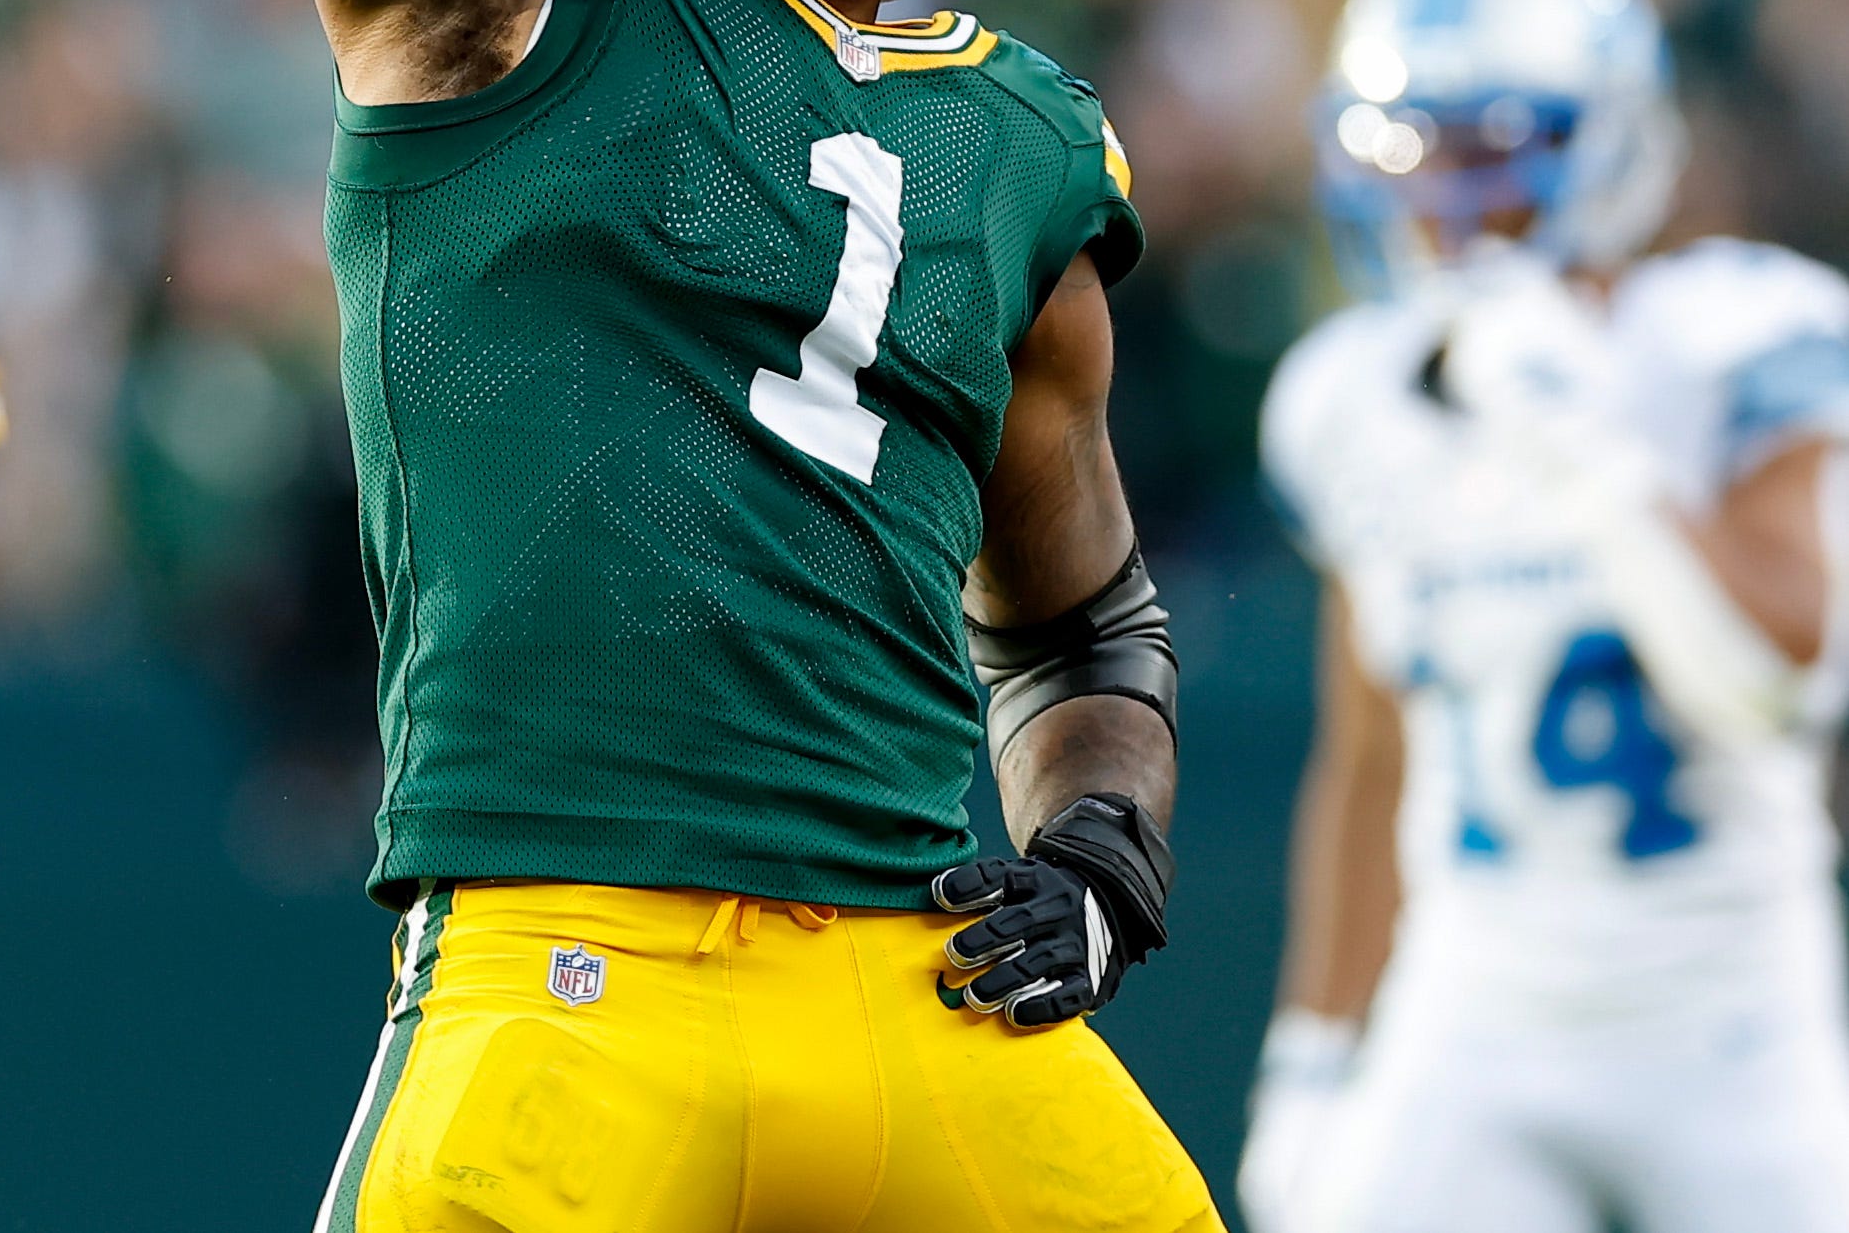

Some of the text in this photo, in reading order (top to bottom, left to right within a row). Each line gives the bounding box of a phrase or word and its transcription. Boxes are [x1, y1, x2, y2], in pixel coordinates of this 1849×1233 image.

[844, 44, 874, 72] NFL
[747, 130, 905, 487] 1
[557, 968, 593, 995] NFL
